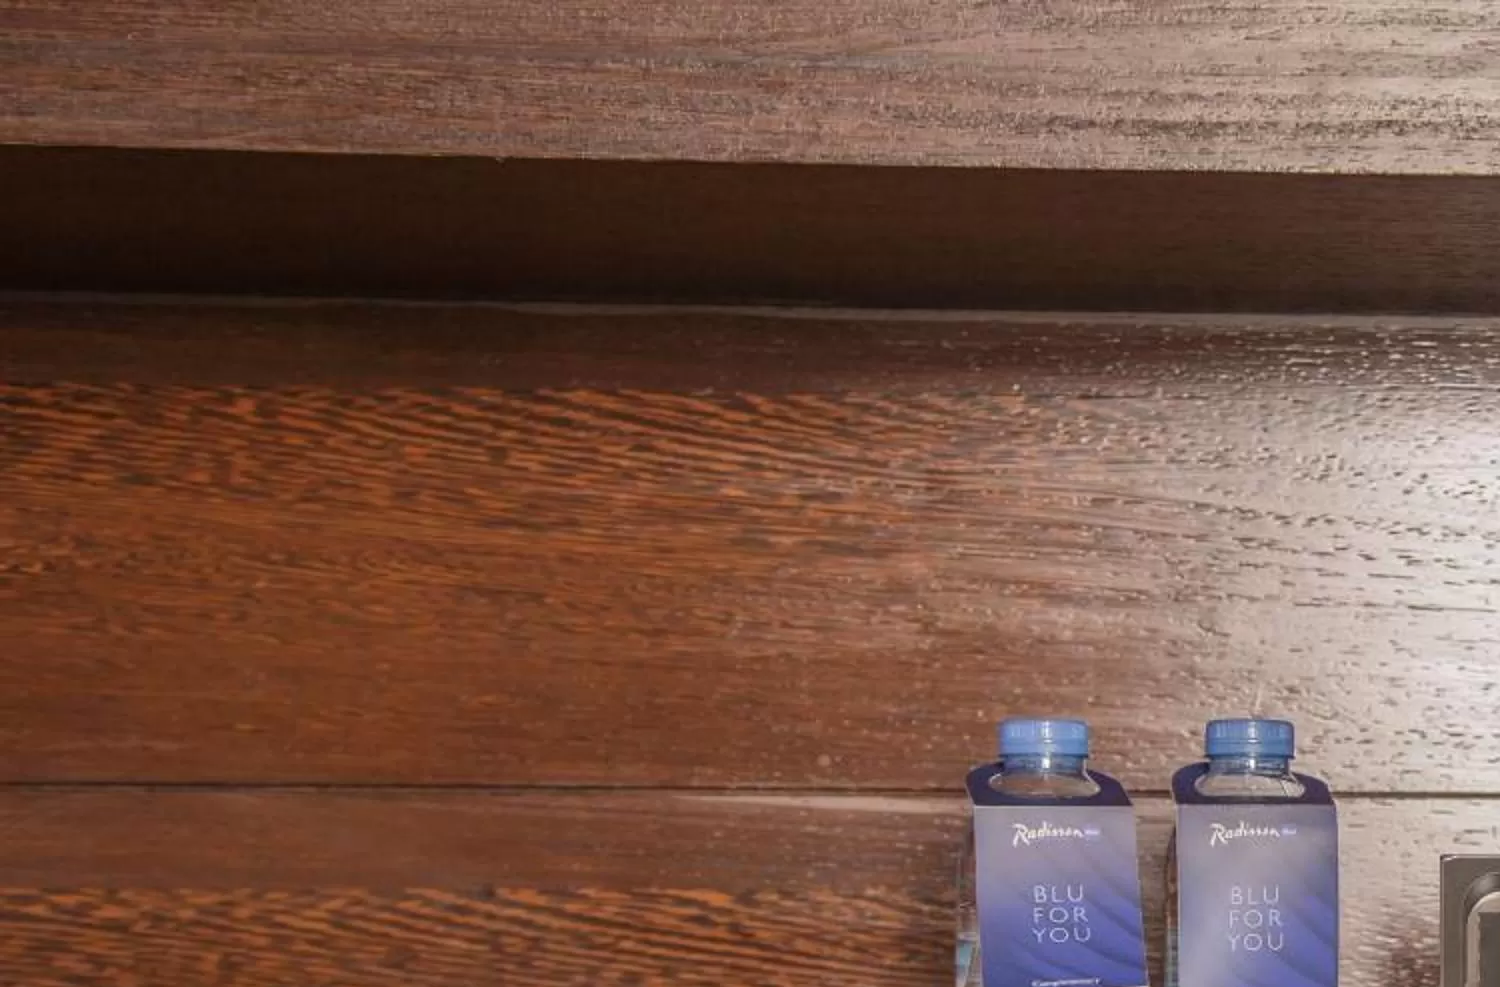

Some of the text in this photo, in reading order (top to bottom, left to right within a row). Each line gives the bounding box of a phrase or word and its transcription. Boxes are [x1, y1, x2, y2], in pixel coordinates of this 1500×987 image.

[1011, 820, 1084, 848] Radisson
[1210, 820, 1280, 848] Radisson
[1033, 884, 1083, 903] BLU
[1231, 885, 1280, 905] BLU
[1033, 907, 1089, 923] FOR
[1228, 909, 1284, 929] FOR
[1031, 927, 1091, 943] YOU
[1227, 932, 1285, 952] YOU
